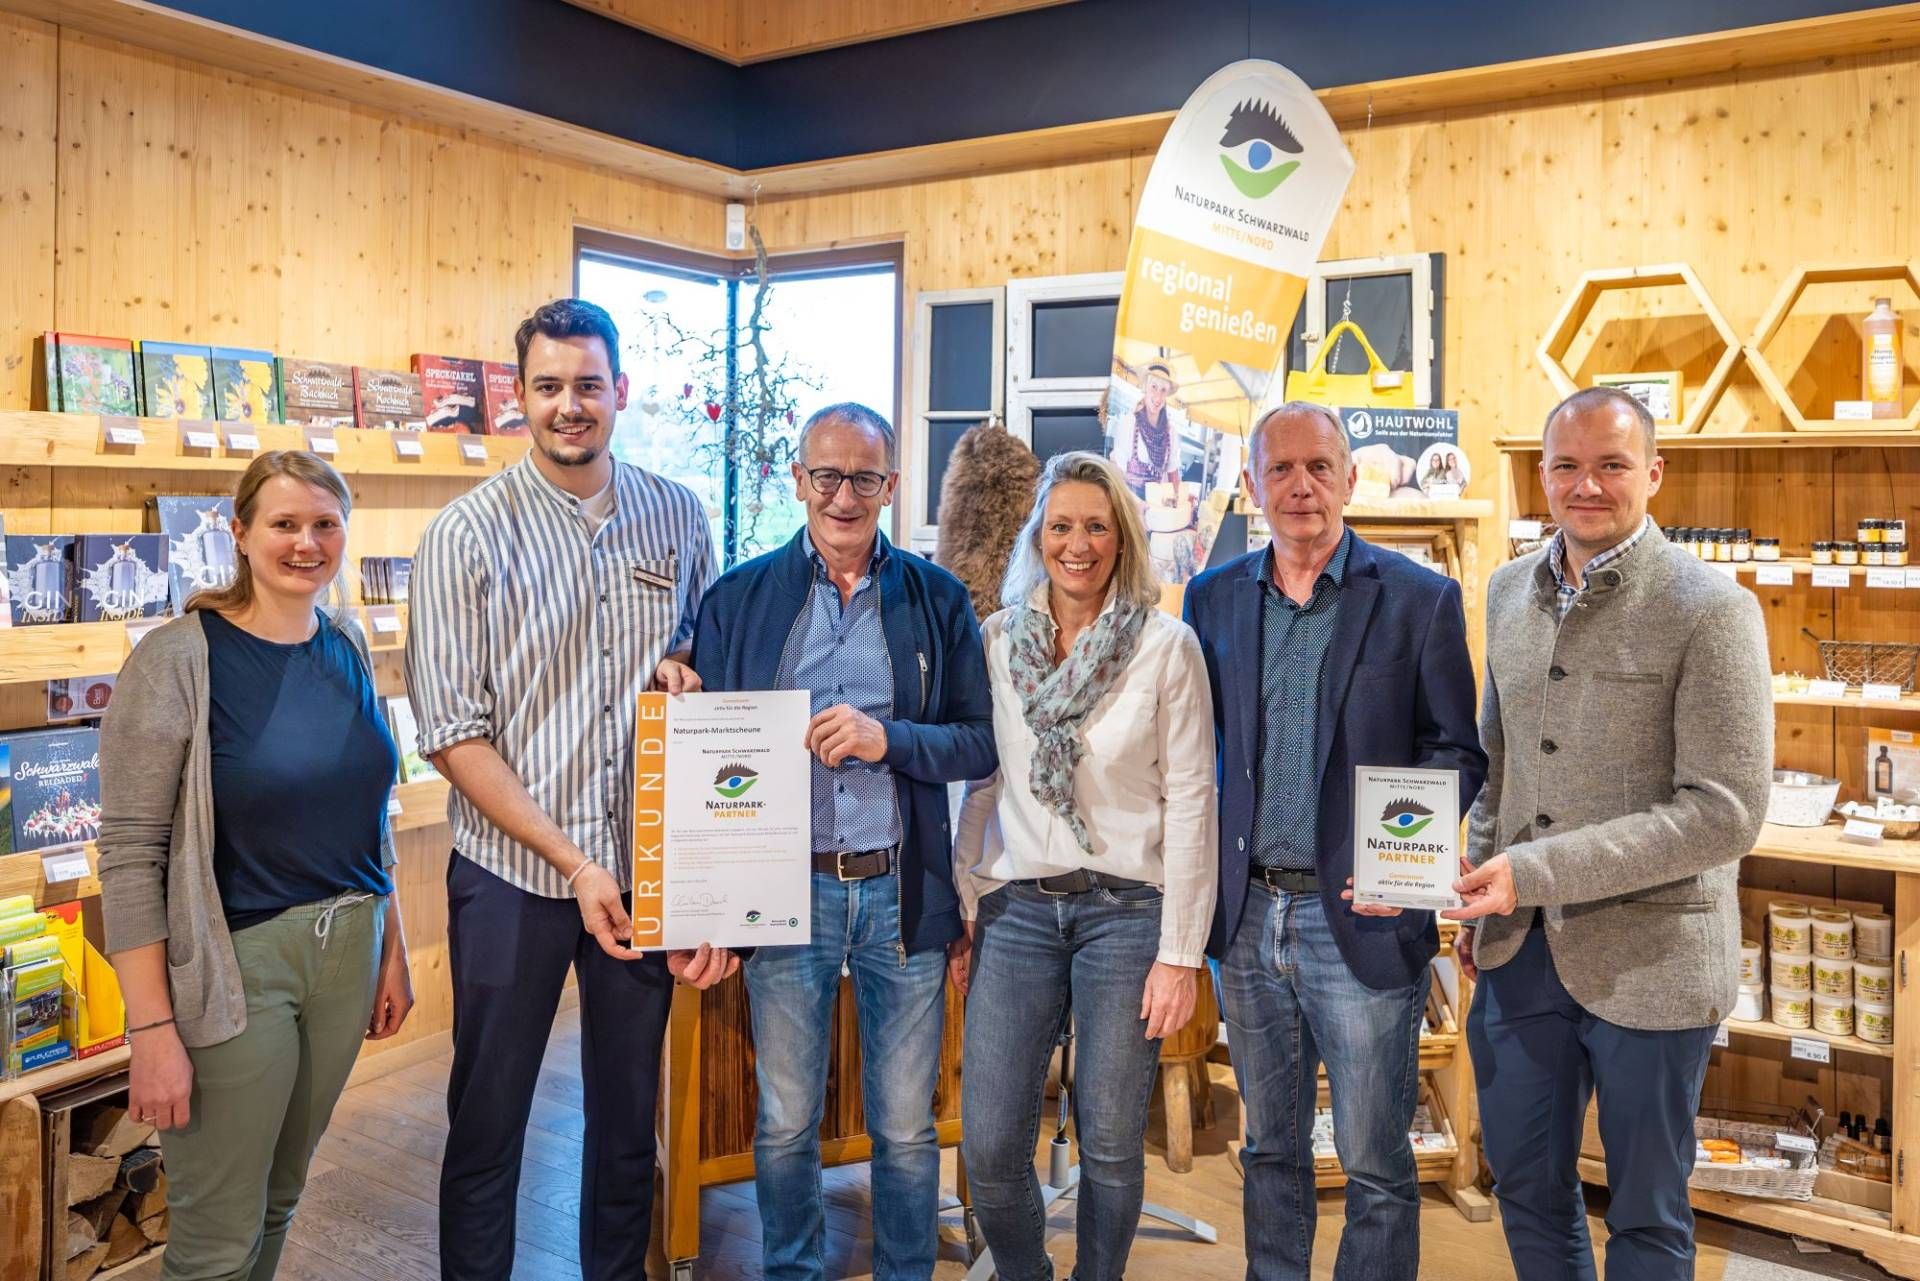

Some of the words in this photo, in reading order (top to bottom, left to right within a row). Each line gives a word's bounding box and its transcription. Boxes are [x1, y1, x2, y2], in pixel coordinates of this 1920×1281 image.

[1175, 185, 1235, 218] NATURPARK
[1238, 209, 1310, 242] SCHWARZWALD
[1211, 222, 1274, 251] MITTE/NORD
[1141, 256, 1233, 303] regional
[1178, 301, 1278, 345] genießen
[1375, 416, 1454, 430] HAUTWOHL
[25, 590, 73, 610] GIN
[100, 589, 145, 609] GIN
[21, 607, 73, 623] INSIDE
[100, 607, 145, 621] INSIDE
[673, 727, 761, 736] Naturpark-Marktscheune
[38, 775, 83, 787] RELOADED
[1403, 778, 1447, 786] SCHWARZWALD
[706, 800, 767, 810] NATURPARK-
[638, 705, 664, 935] URKUNDE
[714, 810, 757, 819] PARTNER
[1367, 838, 1449, 854] NATURPARK-
[1377, 852, 1436, 865] PARTNER
